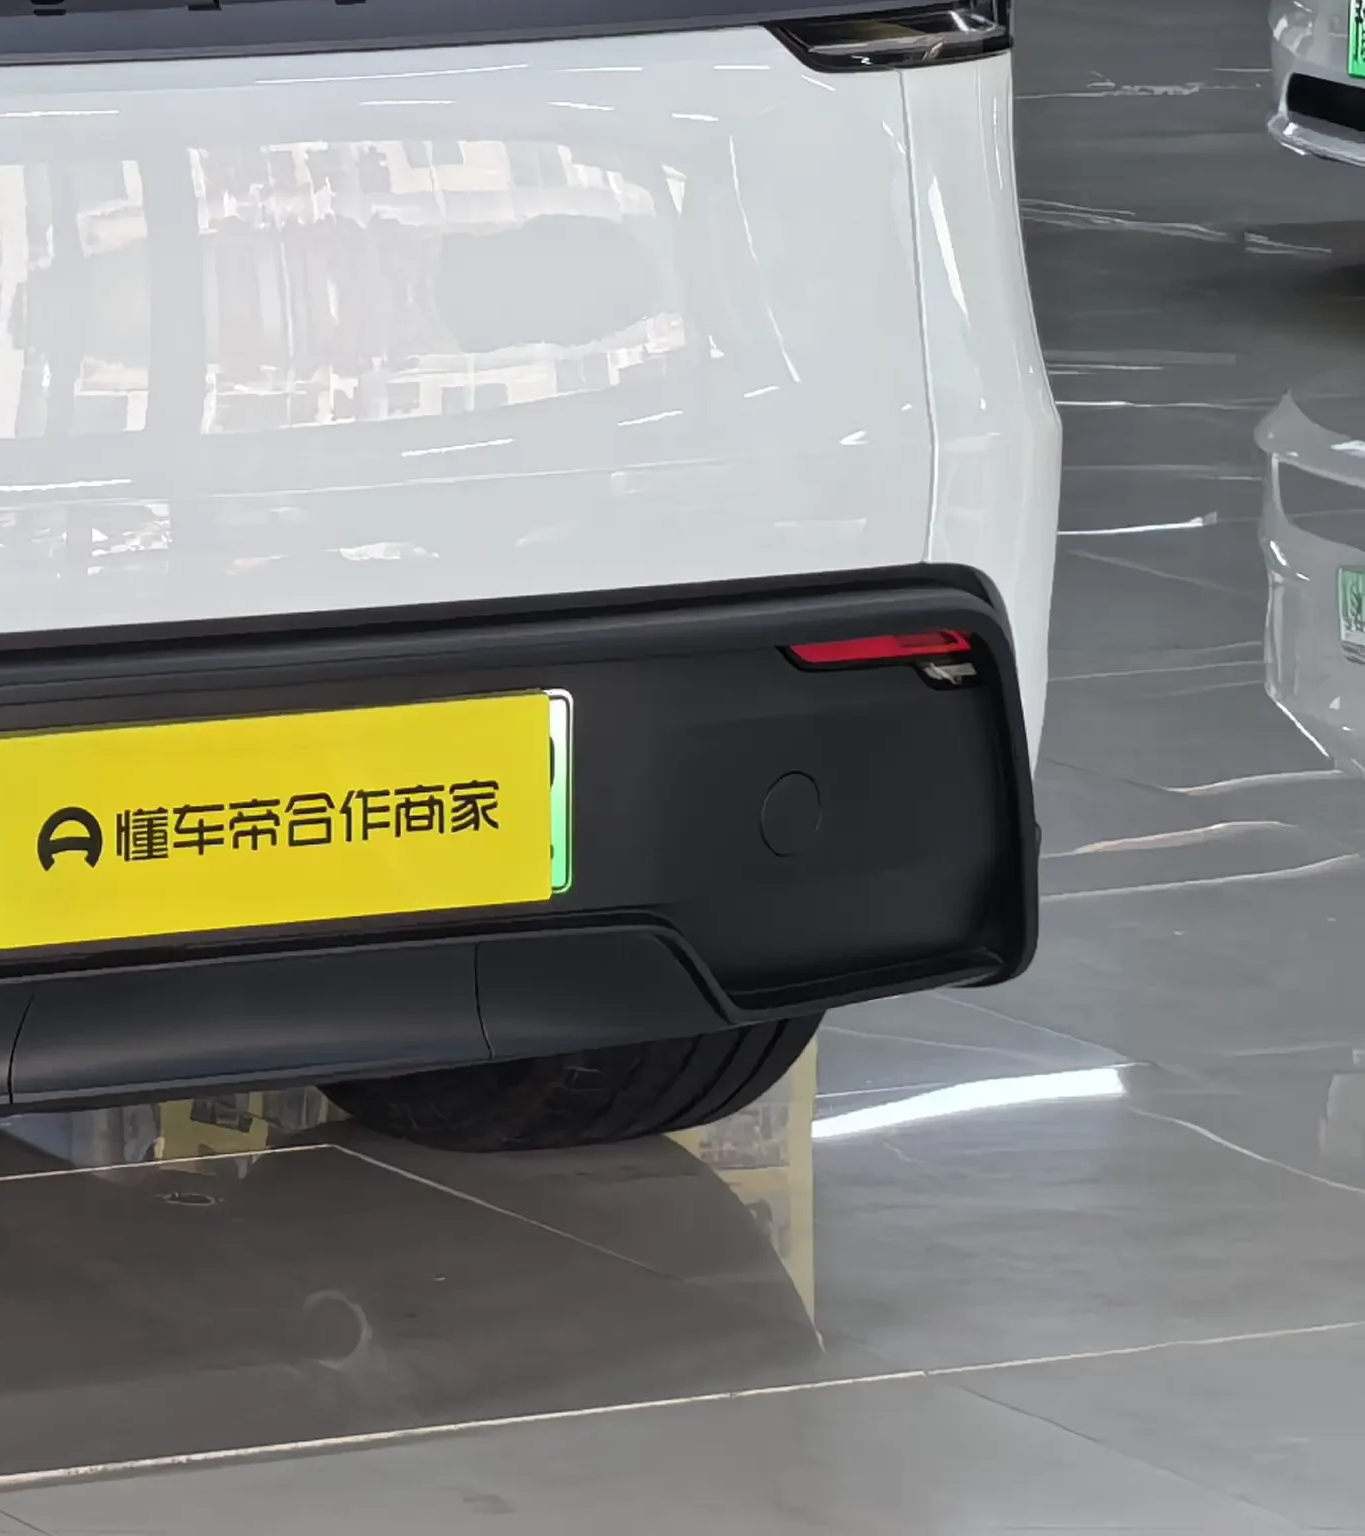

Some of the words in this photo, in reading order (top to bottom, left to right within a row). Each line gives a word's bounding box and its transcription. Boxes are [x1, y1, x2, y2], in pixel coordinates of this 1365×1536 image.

[115, 779, 501, 863] 懂车帝合作商家
